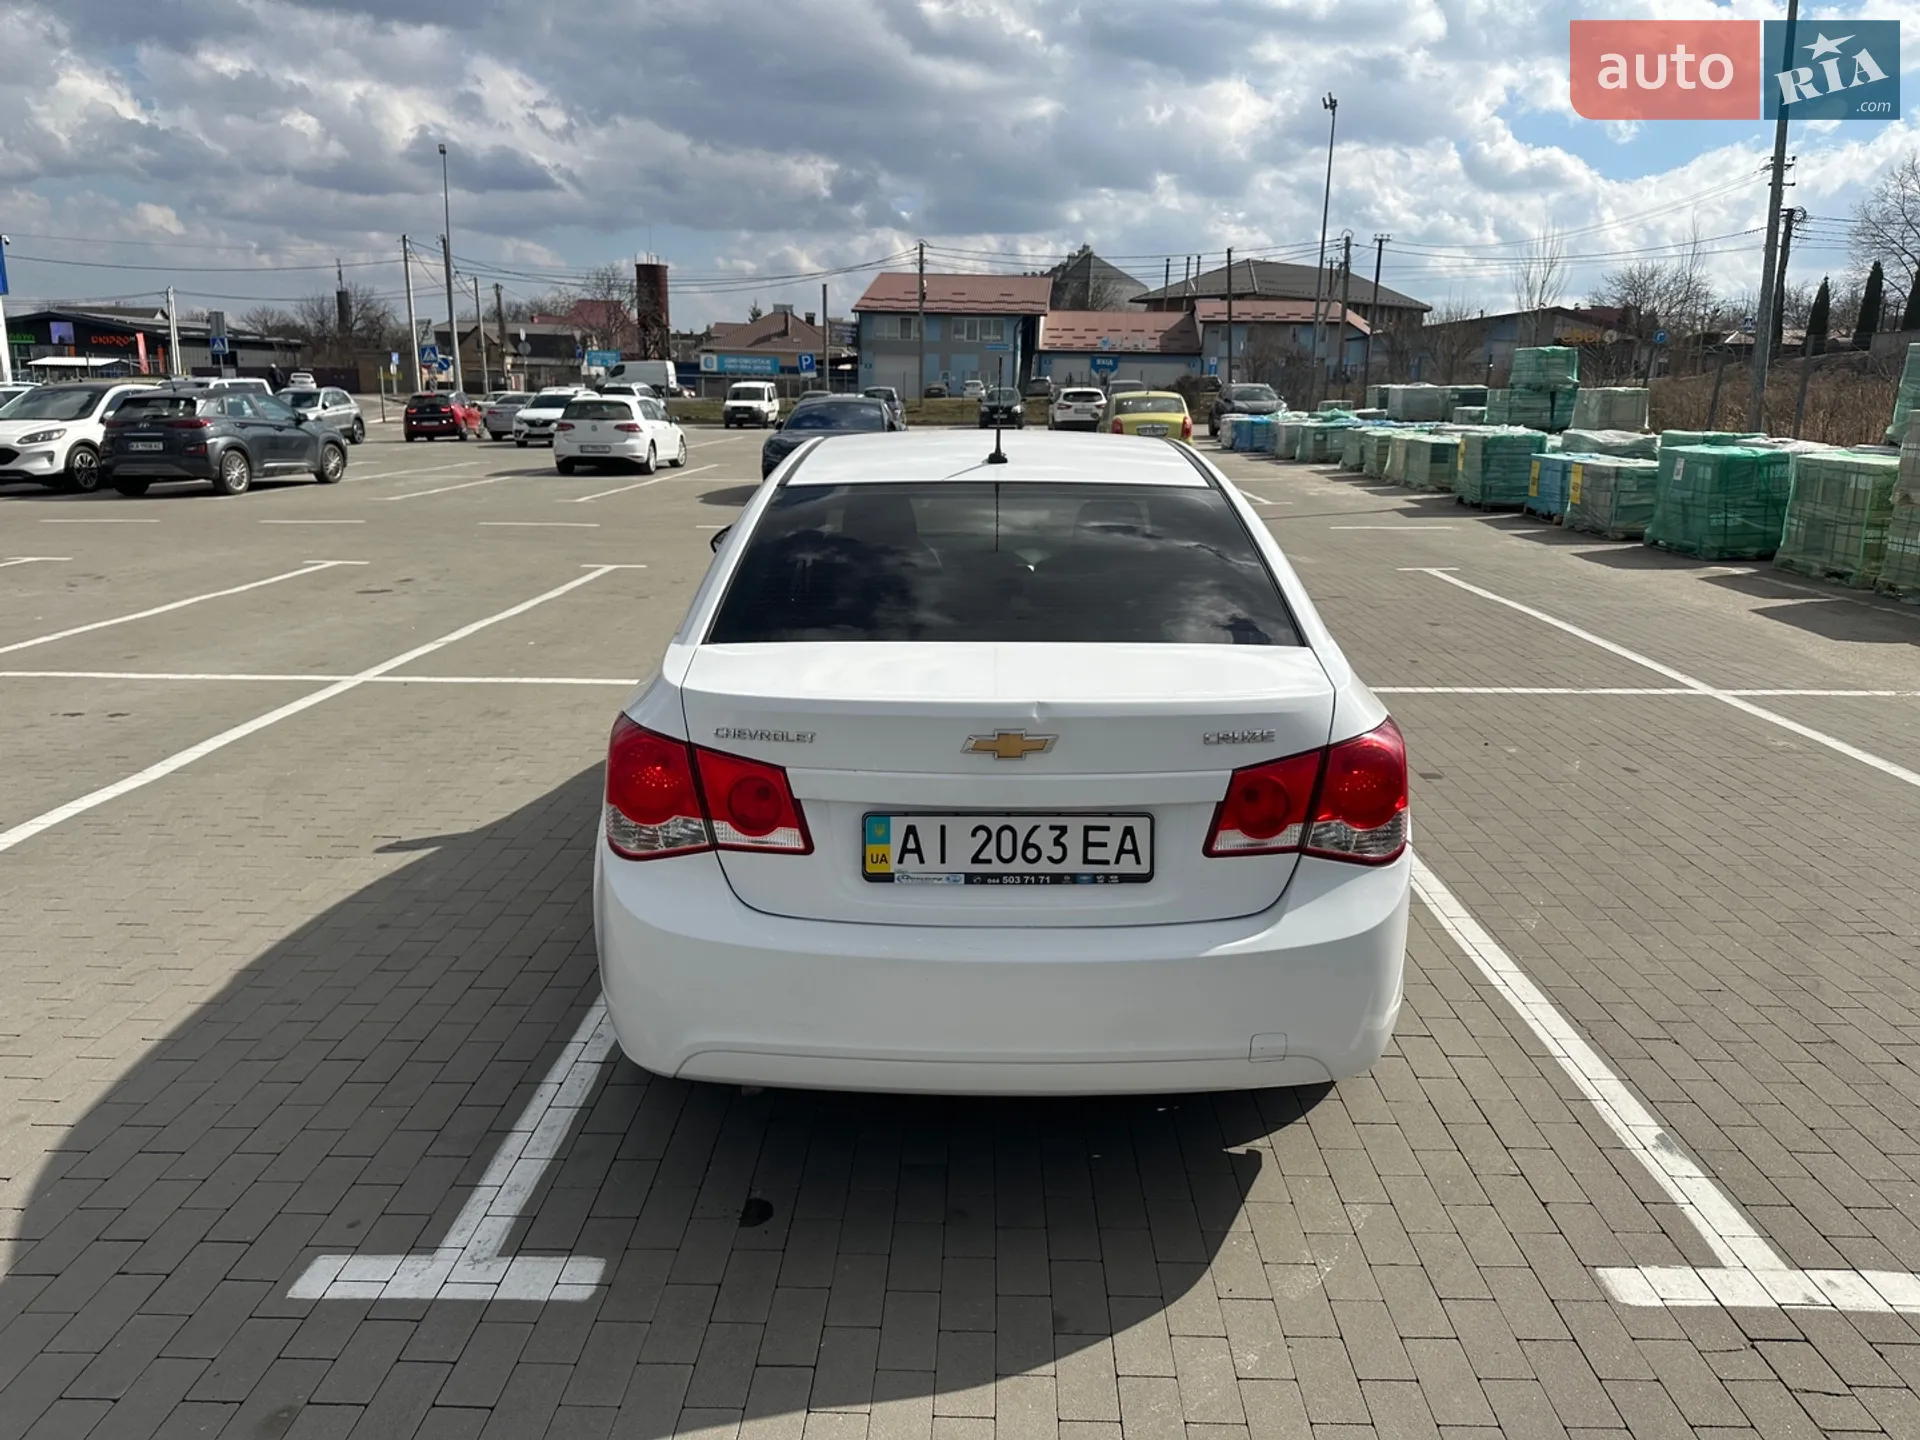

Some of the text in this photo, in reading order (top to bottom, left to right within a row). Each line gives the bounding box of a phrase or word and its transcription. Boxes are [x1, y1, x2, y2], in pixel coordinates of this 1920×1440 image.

[801, 355, 811, 369] P
[713, 727, 817, 744] CHEVROLET
[1203, 728, 1276, 746] CRUZE
[897, 824, 1142, 865] AI 2063 EA
[870, 853, 888, 864] UA
[1002, 876, 1021, 884] 503
[1023, 876, 1036, 884] 71
[1038, 876, 1051, 884] 71
